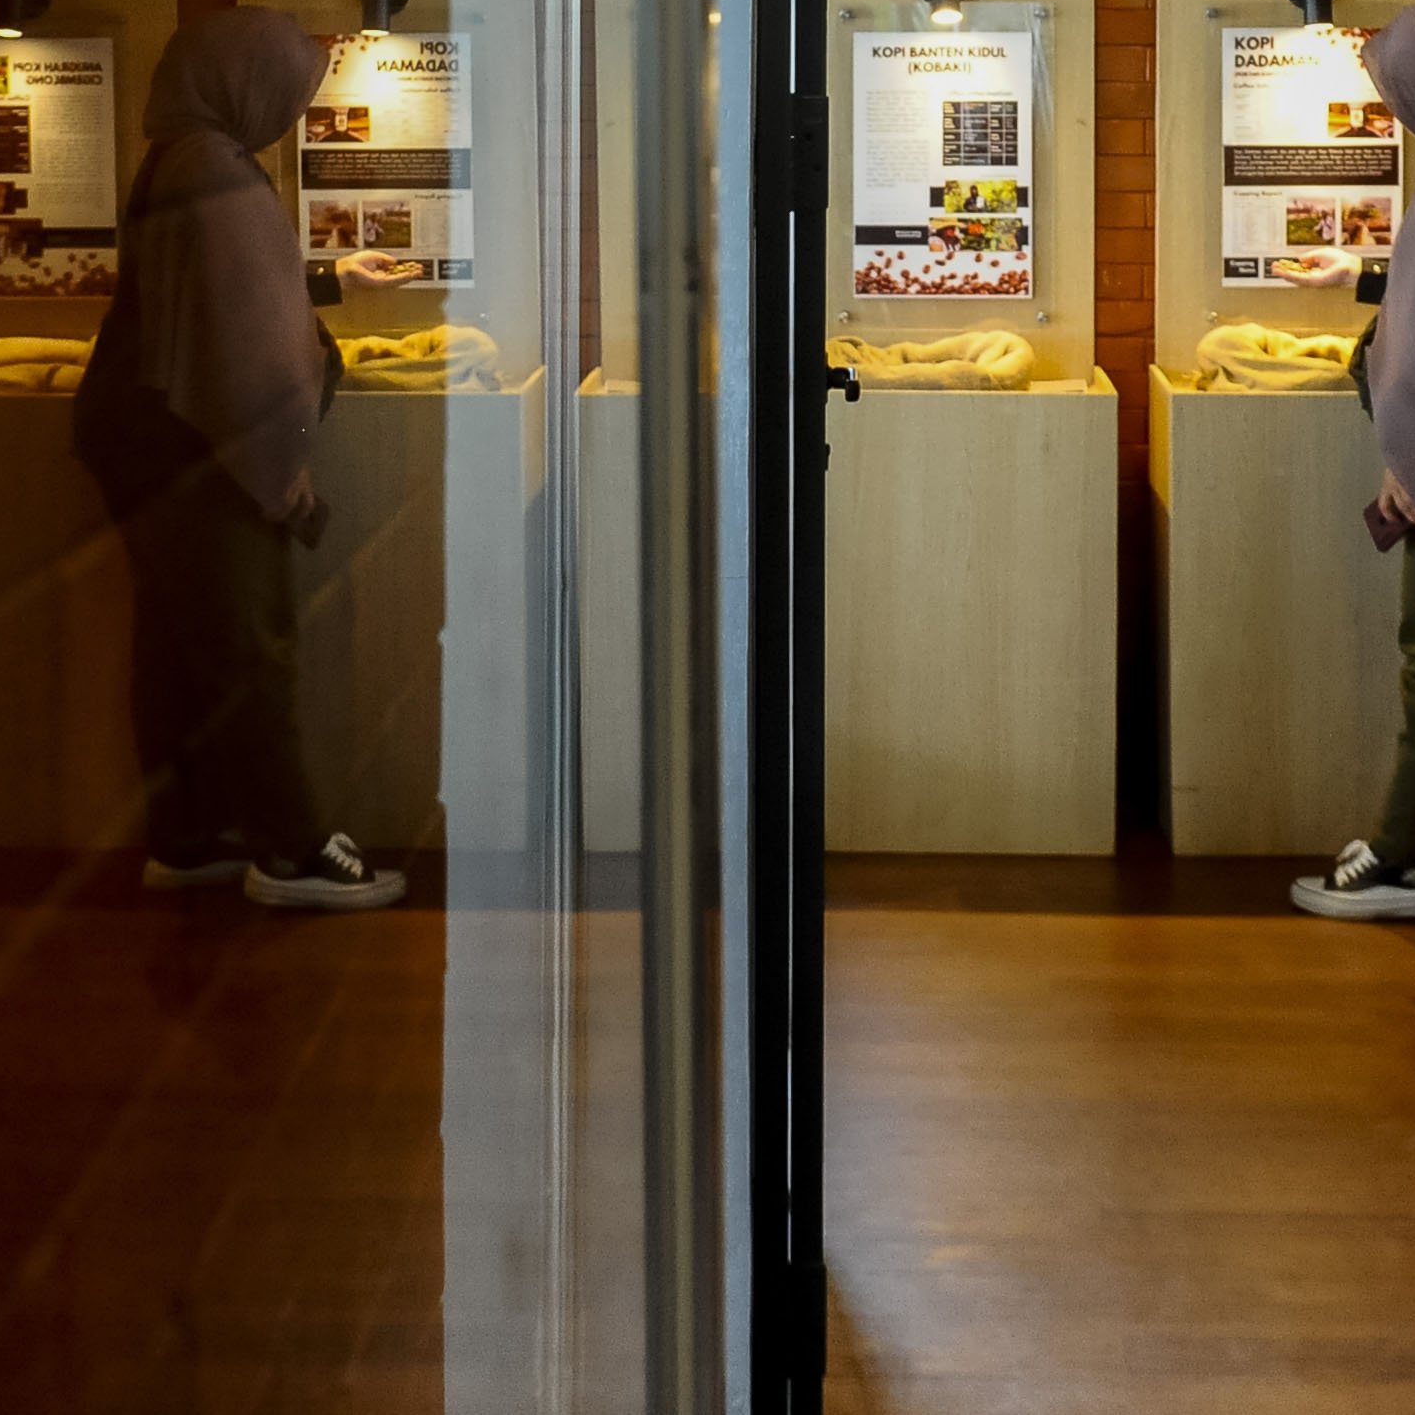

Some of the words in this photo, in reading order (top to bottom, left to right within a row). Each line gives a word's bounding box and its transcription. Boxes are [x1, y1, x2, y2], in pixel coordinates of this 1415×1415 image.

[1234, 36, 1275, 50] KOPI
[872, 46, 906, 58] KOPI
[909, 46, 964, 58] BANTEN
[968, 46, 1007, 58] KIDUL
[908, 60, 972, 74] (KOBAKI)
